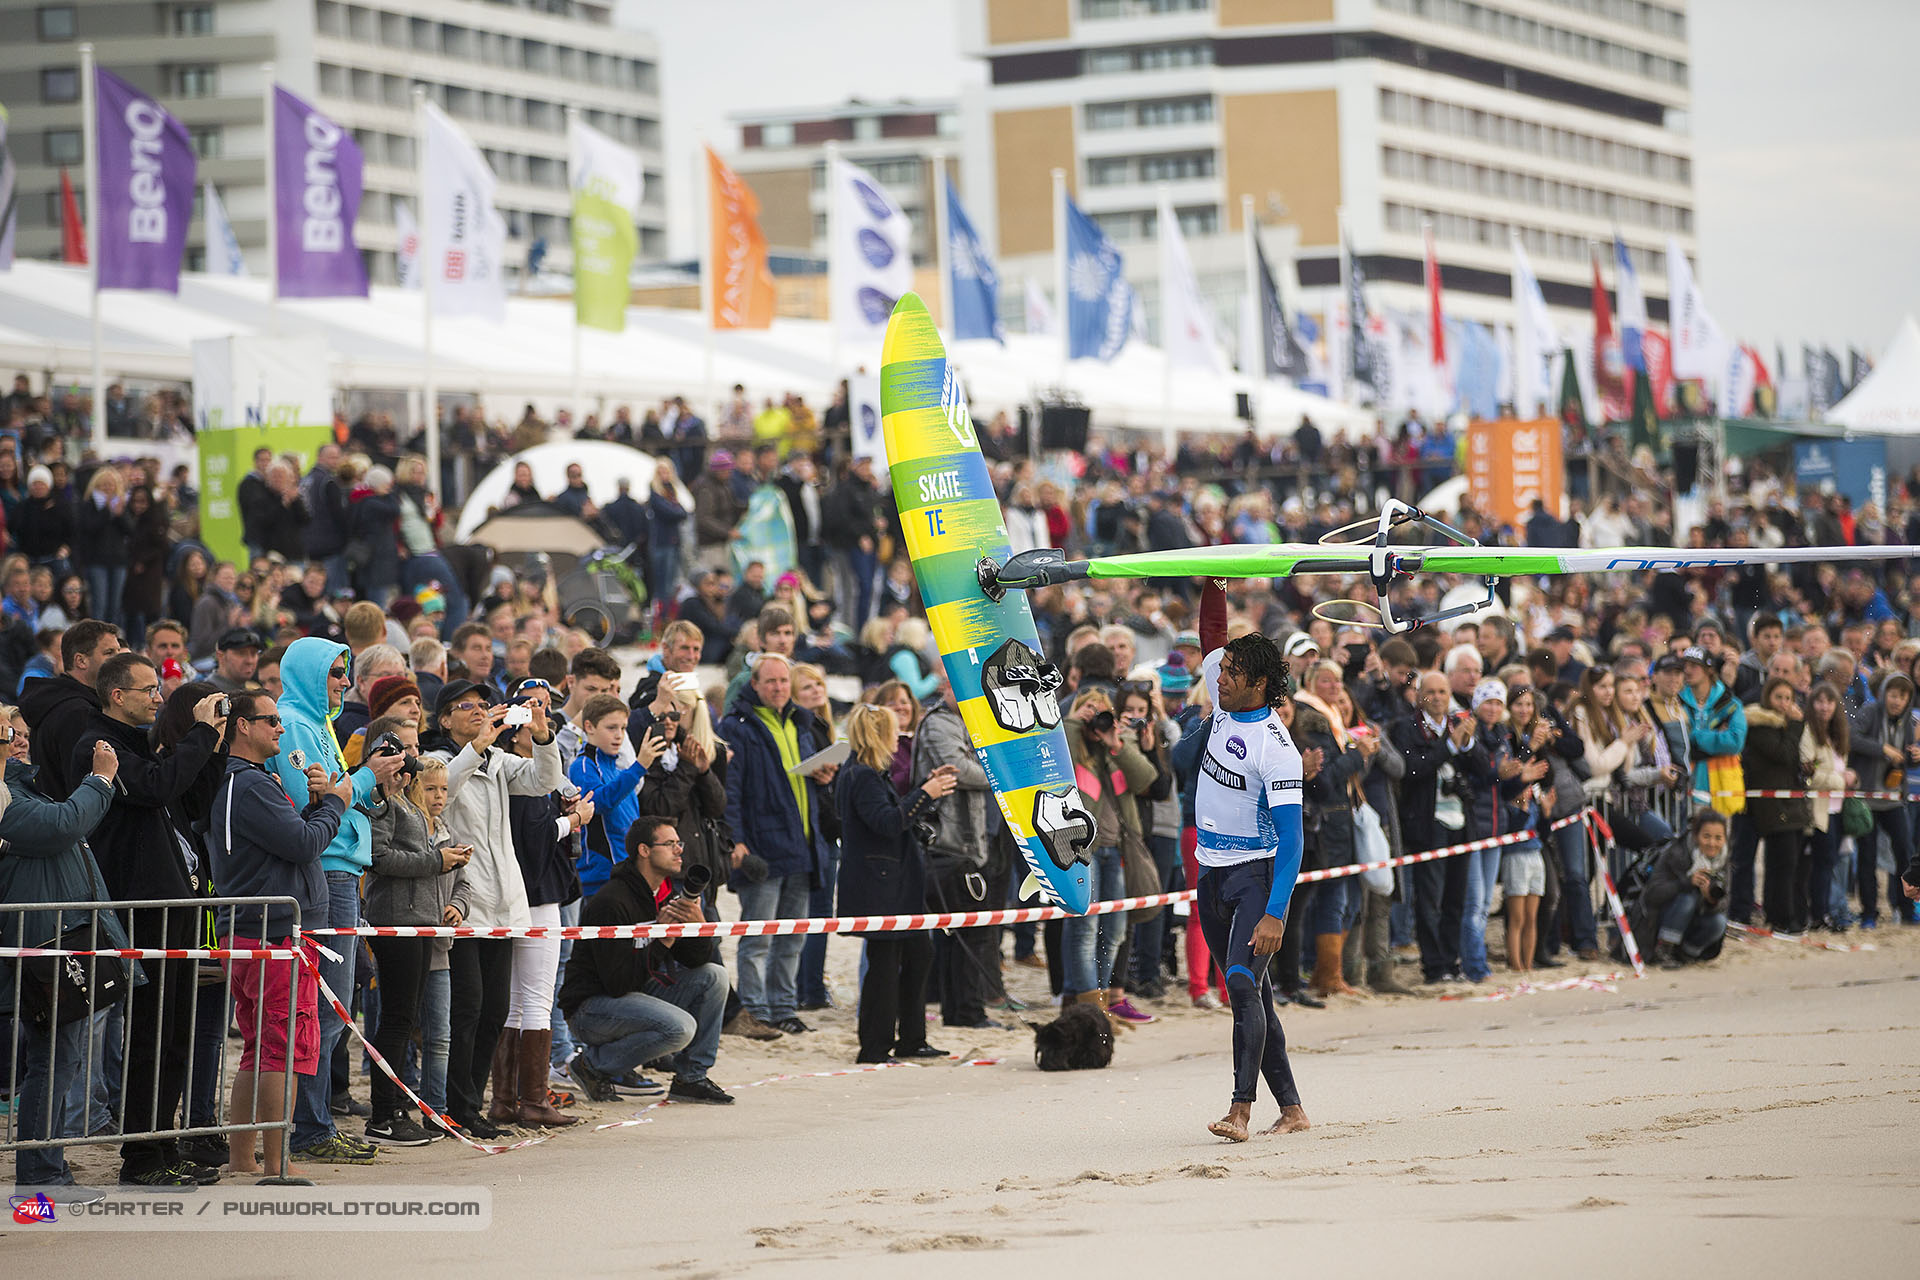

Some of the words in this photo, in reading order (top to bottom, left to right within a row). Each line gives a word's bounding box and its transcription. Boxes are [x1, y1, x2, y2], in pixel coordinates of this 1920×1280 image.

[125, 101, 168, 244] BenQ
[918, 471, 962, 502] SKATE
[925, 509, 946, 537] TE
[1227, 739, 1245, 757] BenQ
[1215, 766, 1241, 788] DAVID
[1008, 820, 1067, 905] FANATIC
